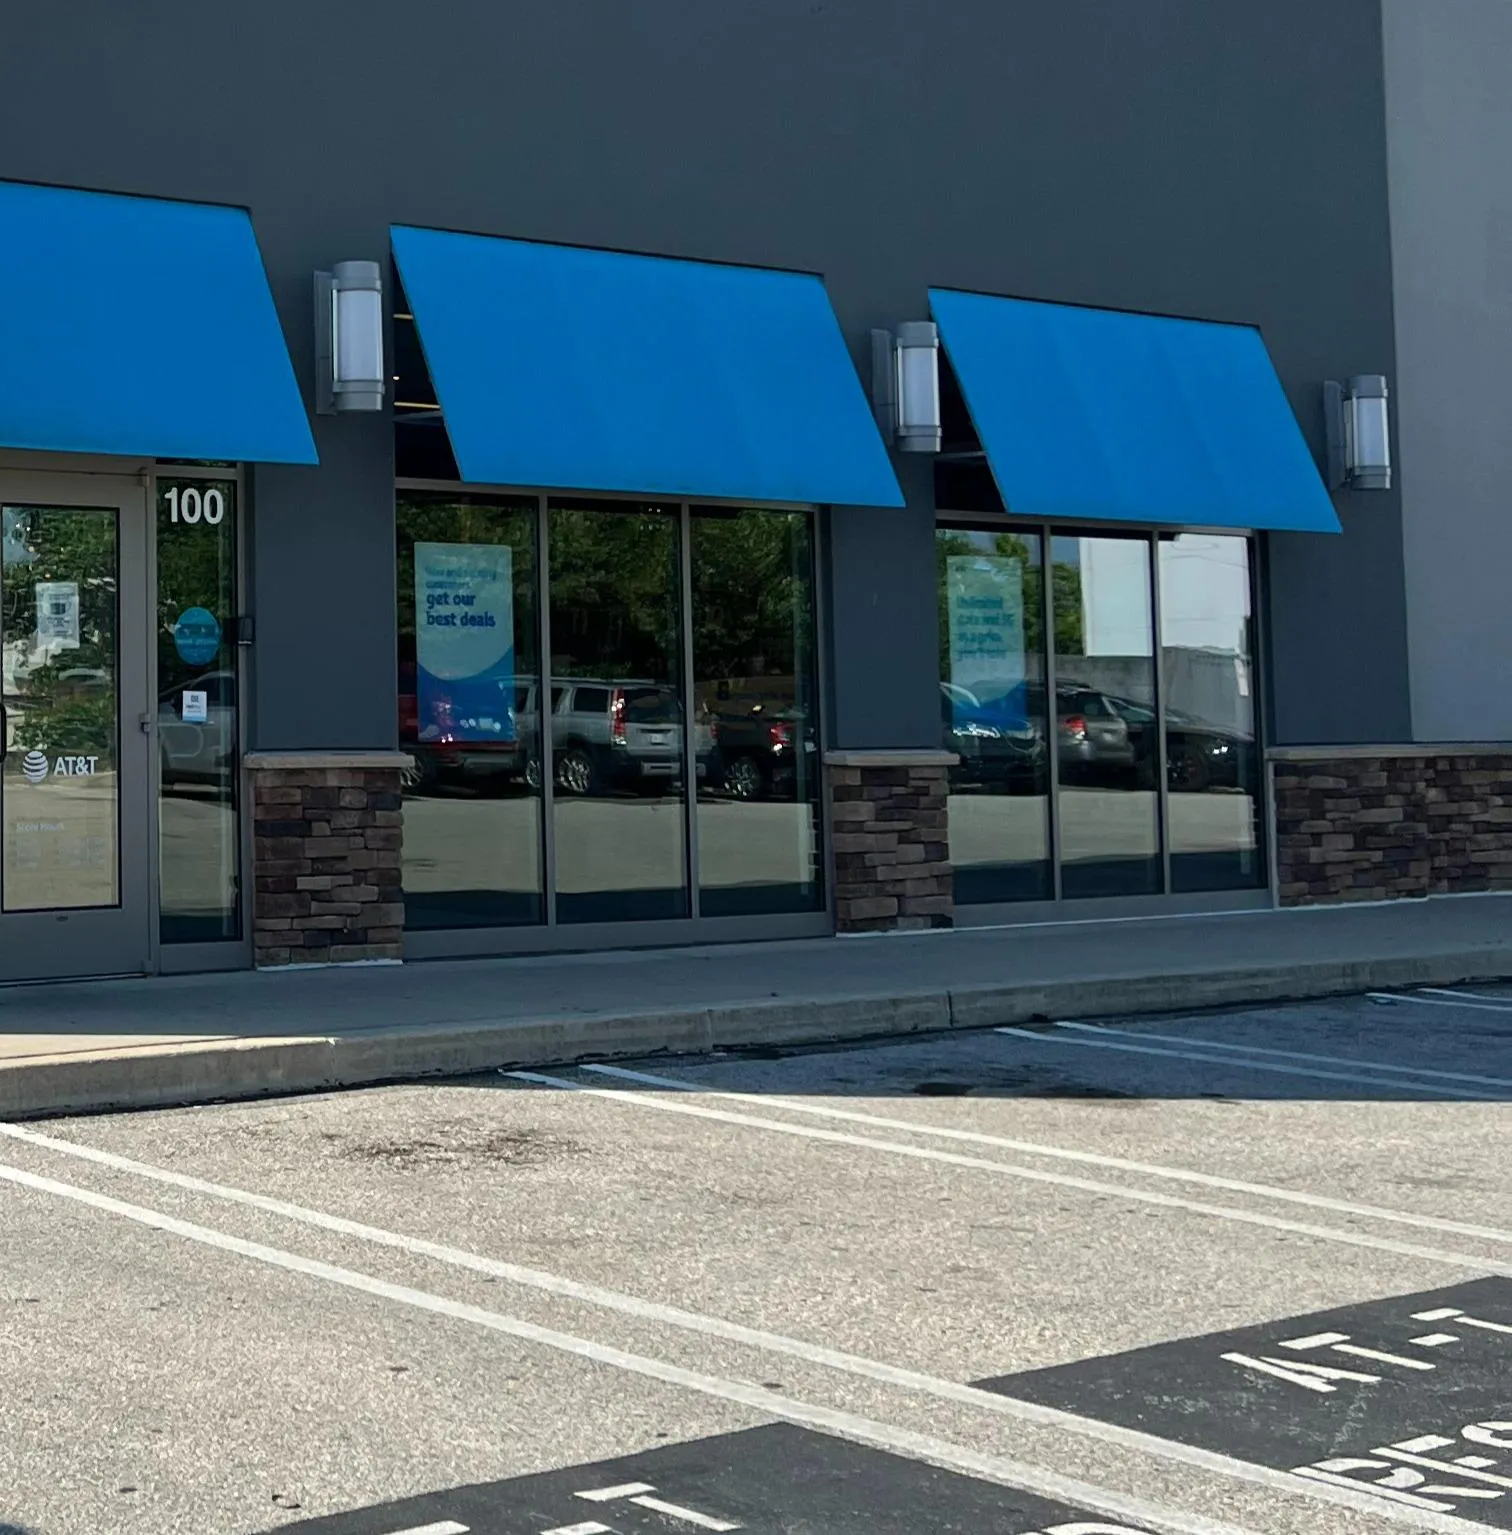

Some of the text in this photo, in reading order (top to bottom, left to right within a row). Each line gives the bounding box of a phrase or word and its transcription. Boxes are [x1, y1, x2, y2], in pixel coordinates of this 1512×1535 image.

[164, 486, 225, 525] 100
[426, 591, 477, 609] get our
[426, 611, 497, 628] best deals
[53, 755, 99, 777] AT&T
